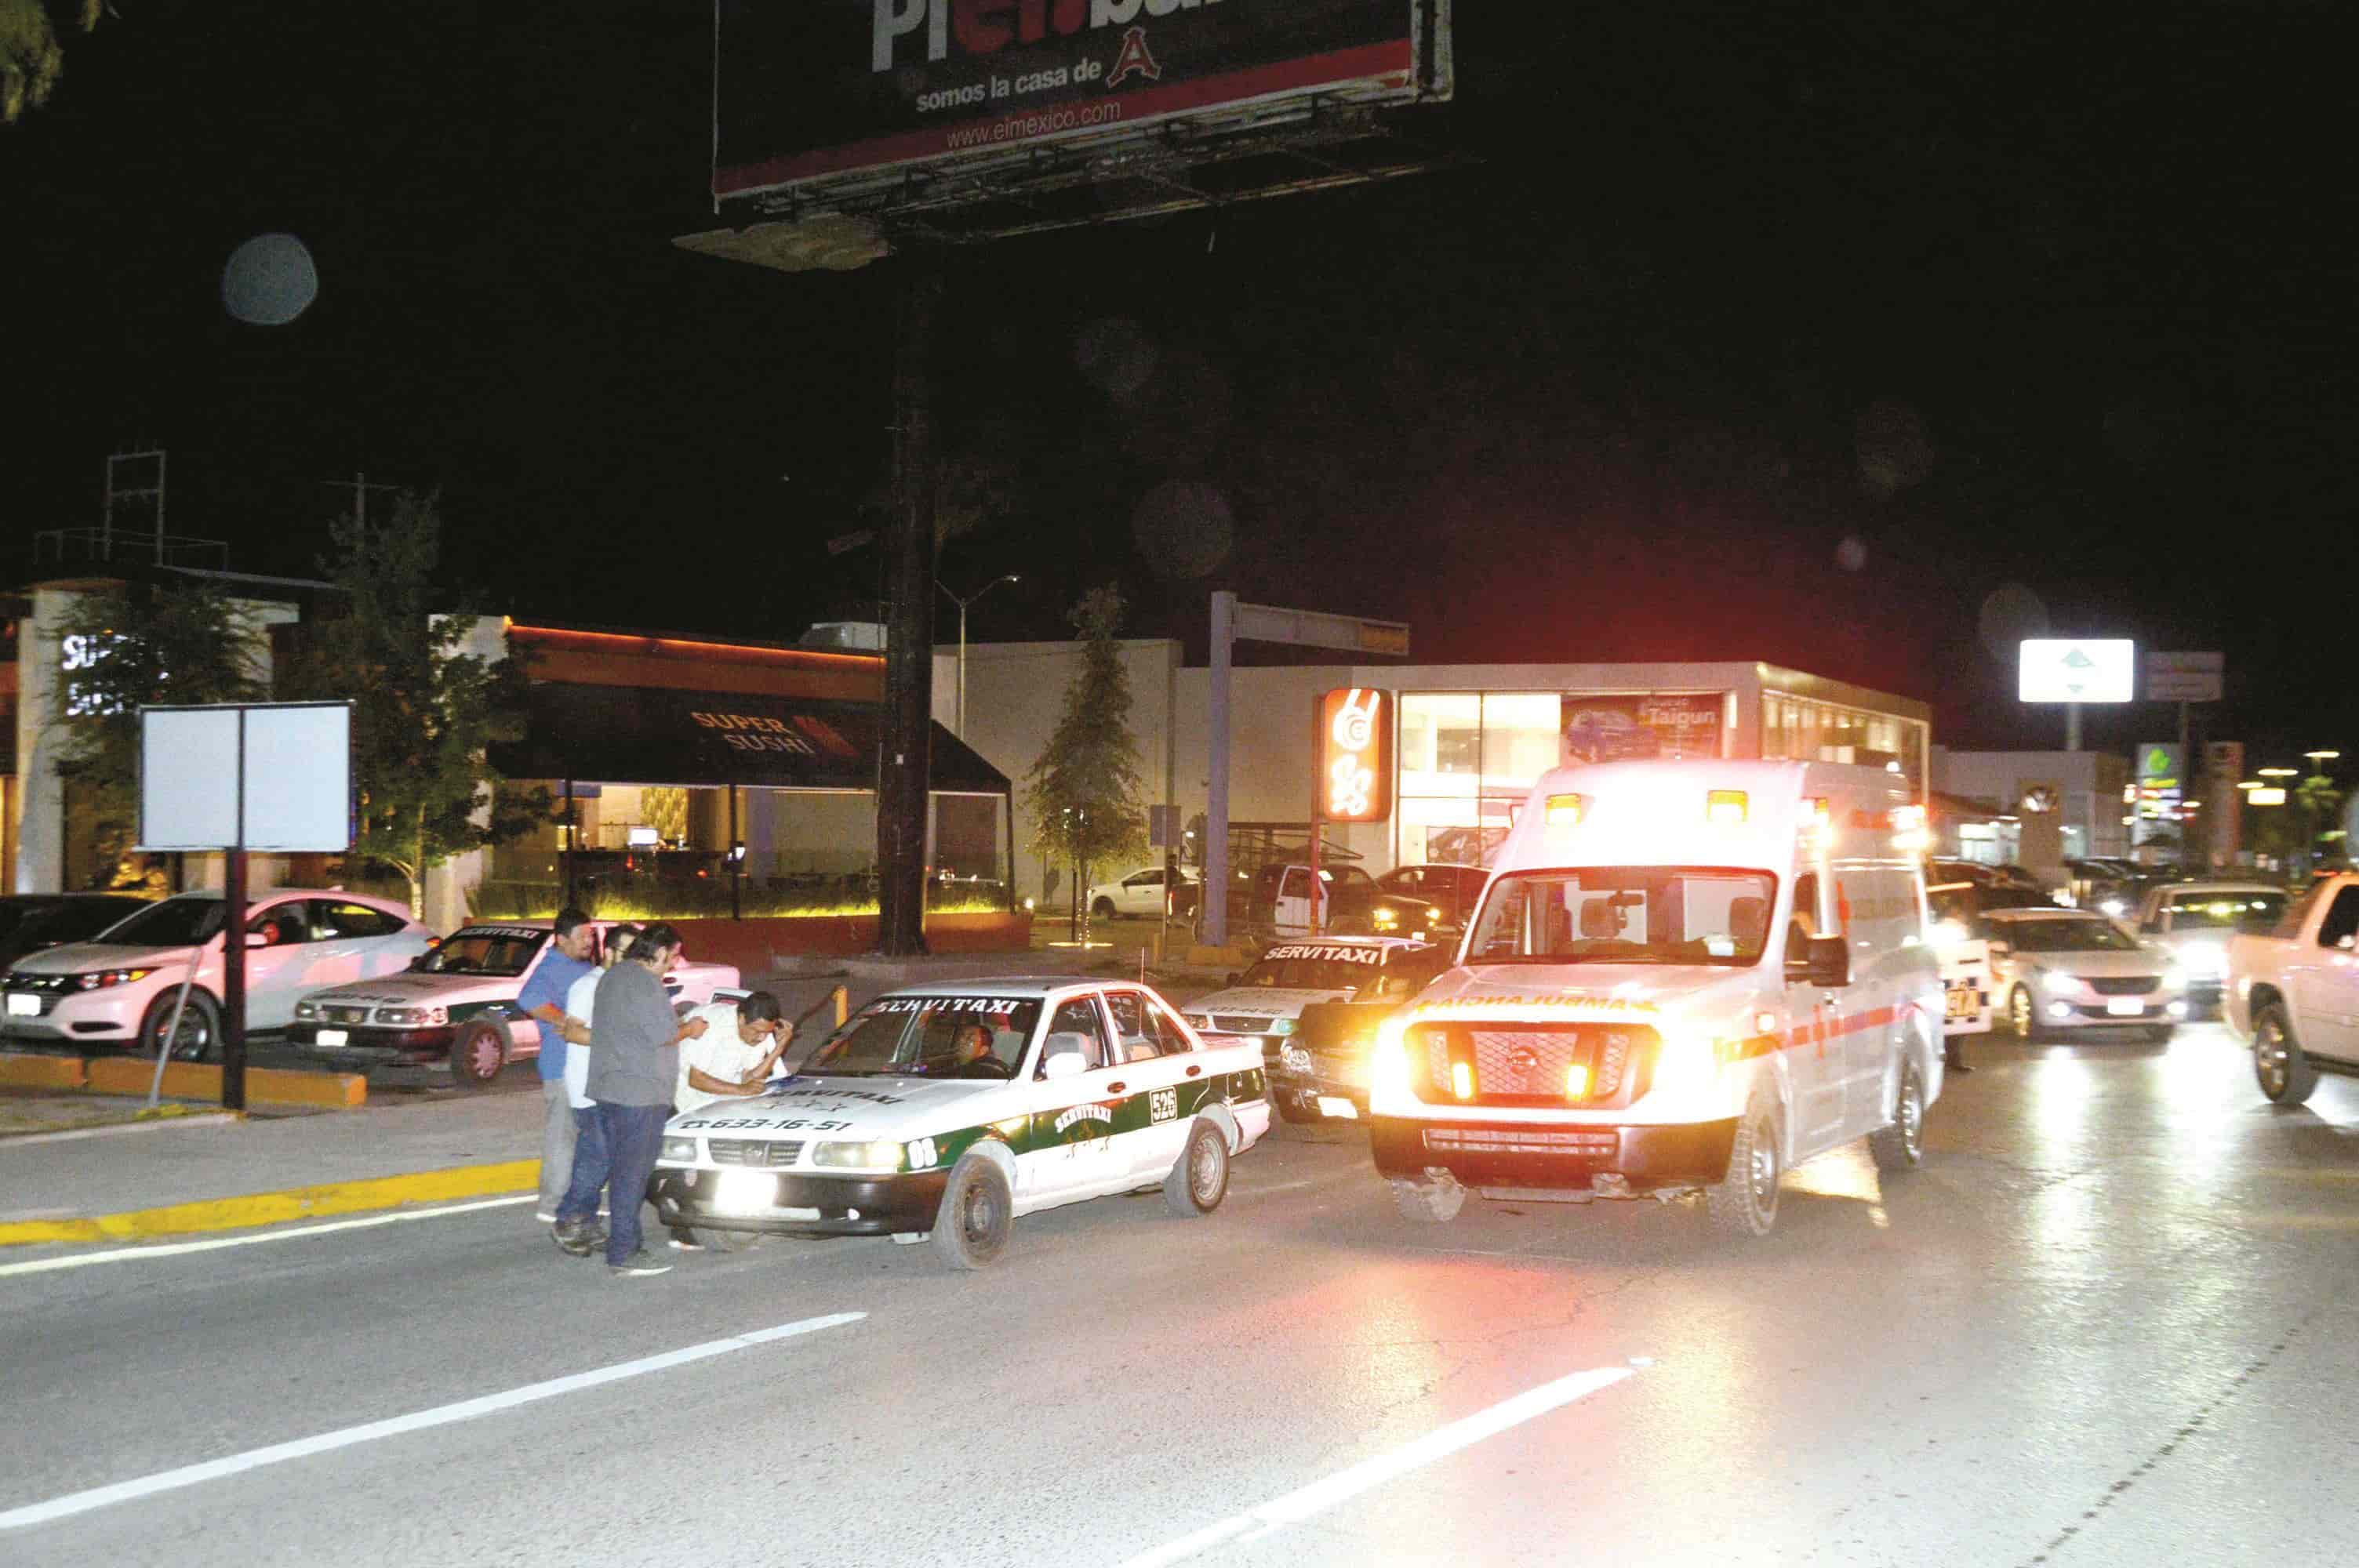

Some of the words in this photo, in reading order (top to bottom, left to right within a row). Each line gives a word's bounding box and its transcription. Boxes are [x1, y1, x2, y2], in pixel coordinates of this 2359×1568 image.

[916, 81, 985, 112] somos
[991, 78, 1009, 99] la
[1016, 67, 1067, 95] casa
[1074, 58, 1102, 83] de
[690, 711, 795, 734] SUPER
[1649, 706, 1716, 729] Taigun
[723, 734, 816, 753] SUSHI
[1264, 946, 1382, 964] SERVITAXI
[876, 998, 1020, 1014] SERVITAXI
[1152, 1090, 1176, 1120] 526
[709, 1118, 853, 1131] 633-16-51
[1054, 1103, 1112, 1134] SERVITAXI
